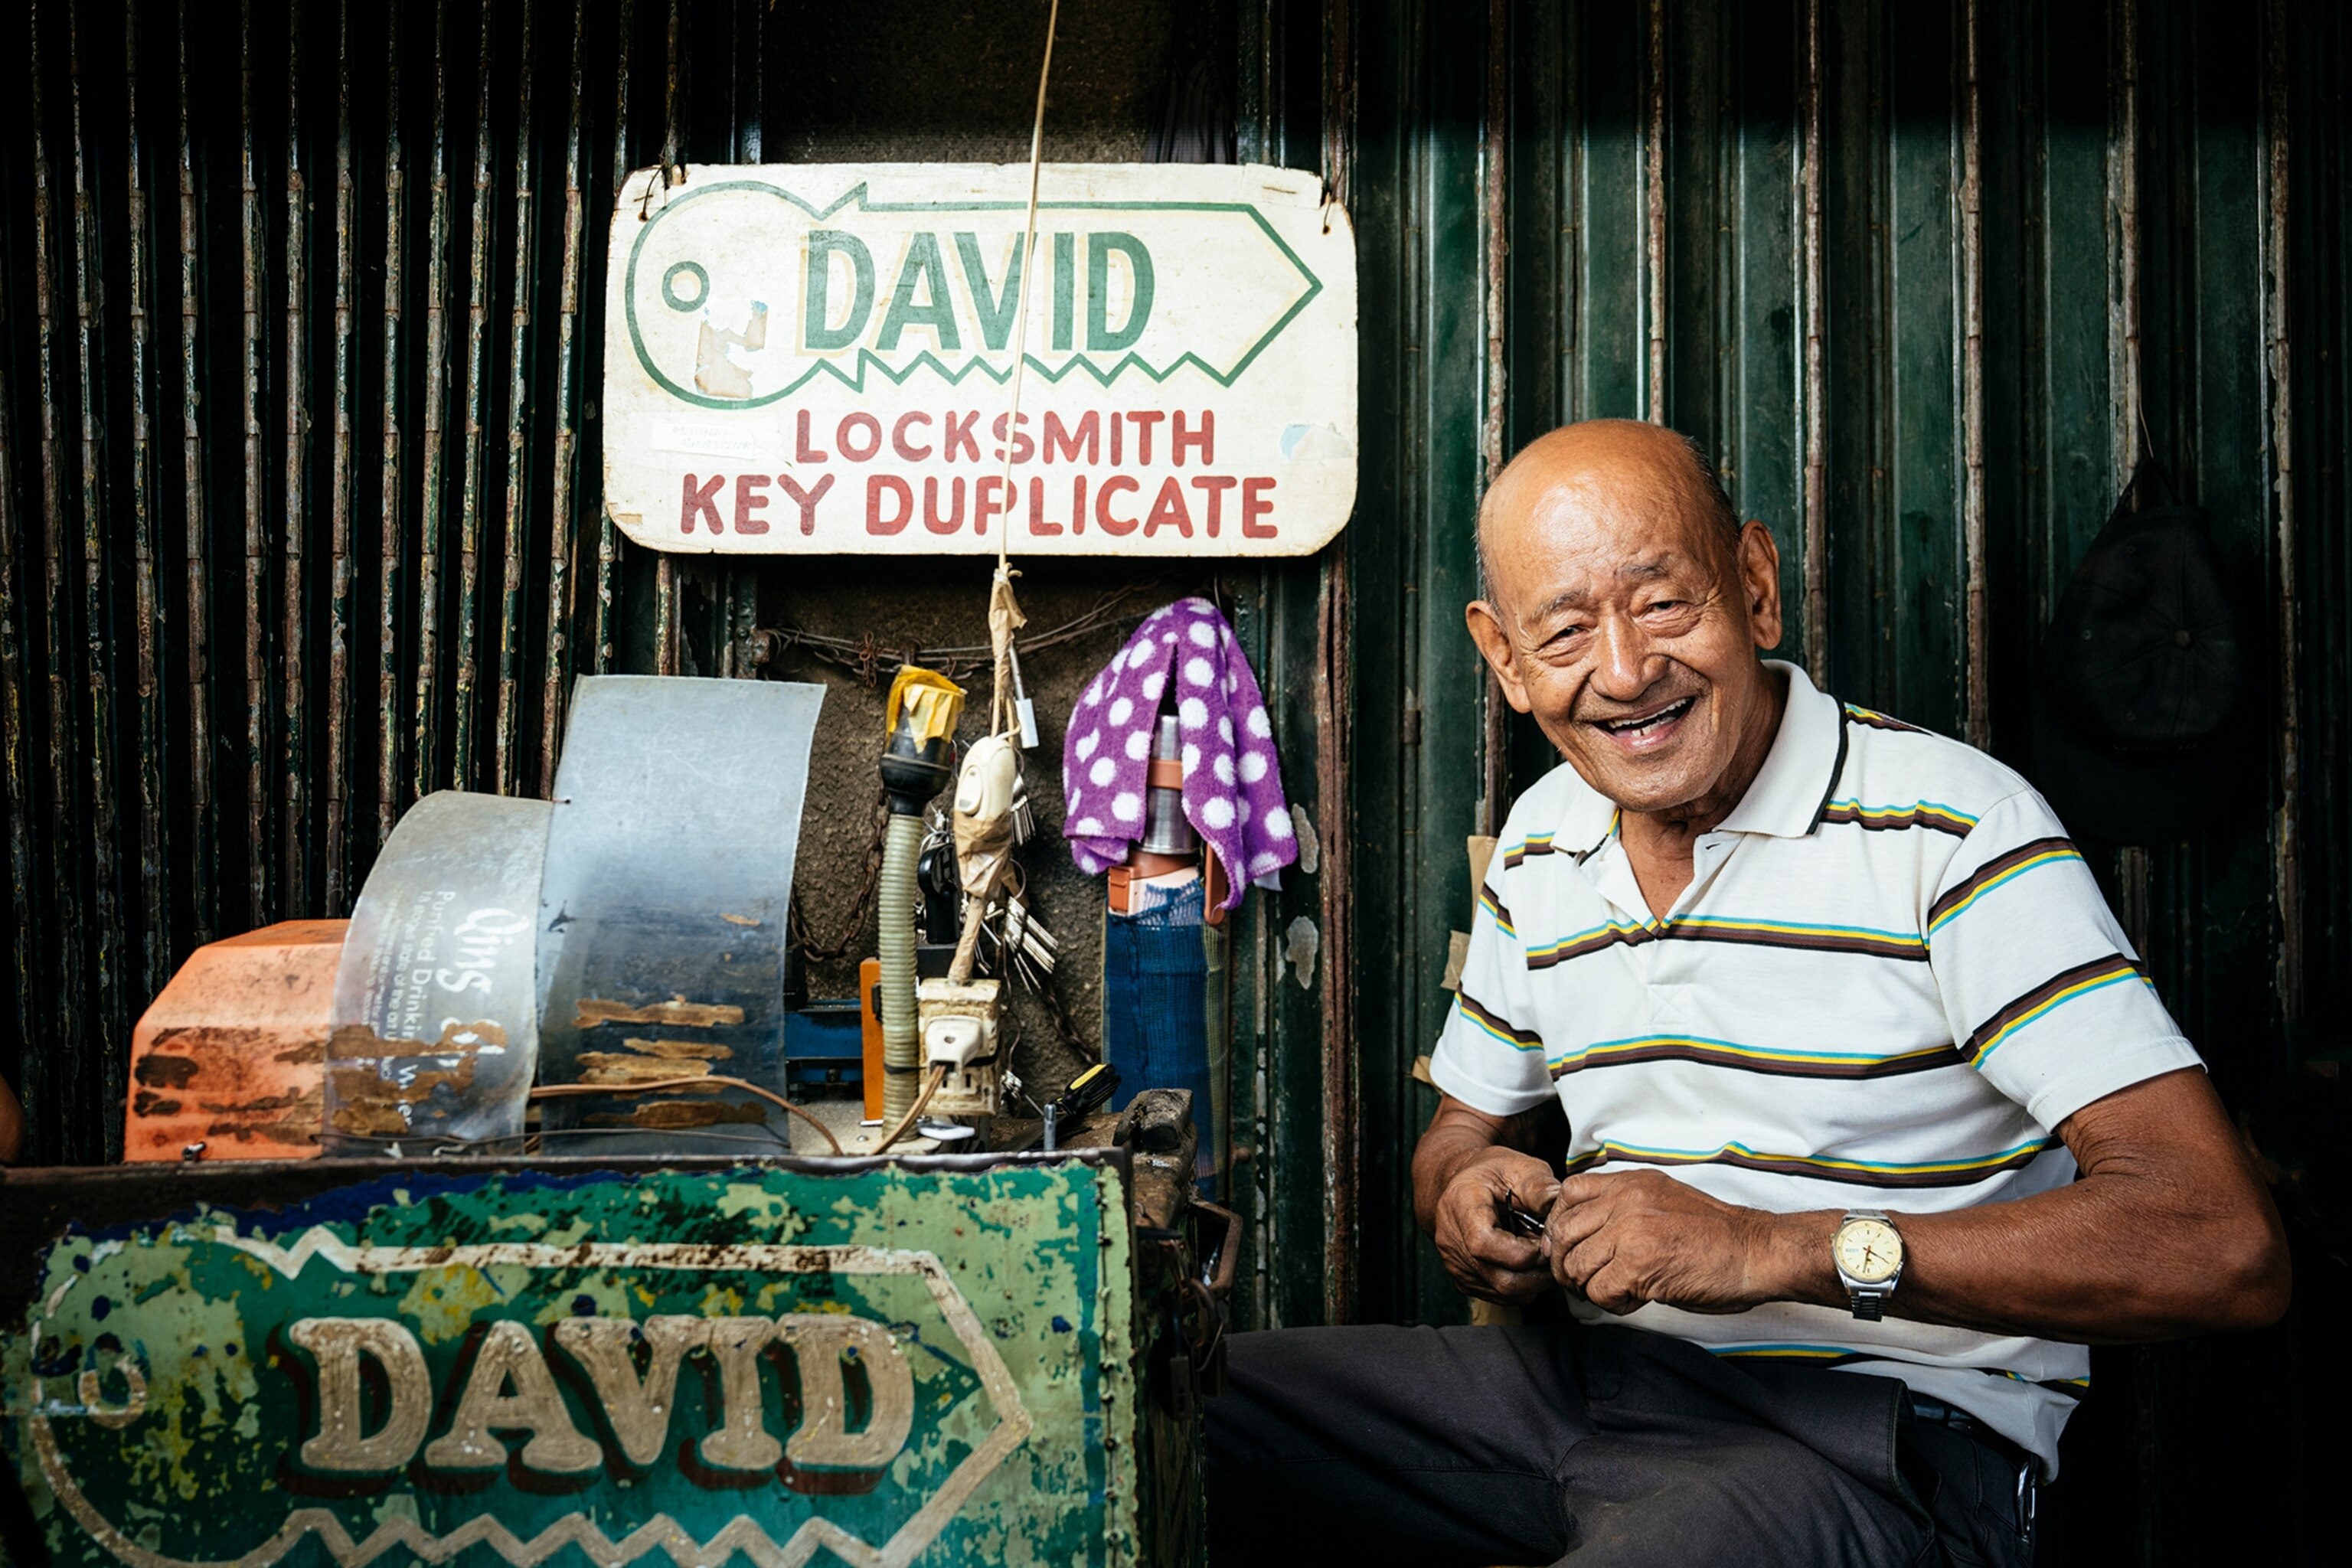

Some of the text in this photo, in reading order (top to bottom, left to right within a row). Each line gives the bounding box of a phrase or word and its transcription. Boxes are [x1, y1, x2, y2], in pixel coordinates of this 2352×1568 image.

[804, 230, 1155, 352] DAVID
[796, 409, 1214, 466] LOCKSMITH
[681, 472, 1278, 539] KEY DUPLICATE
[289, 1314, 916, 1473] DAVID
